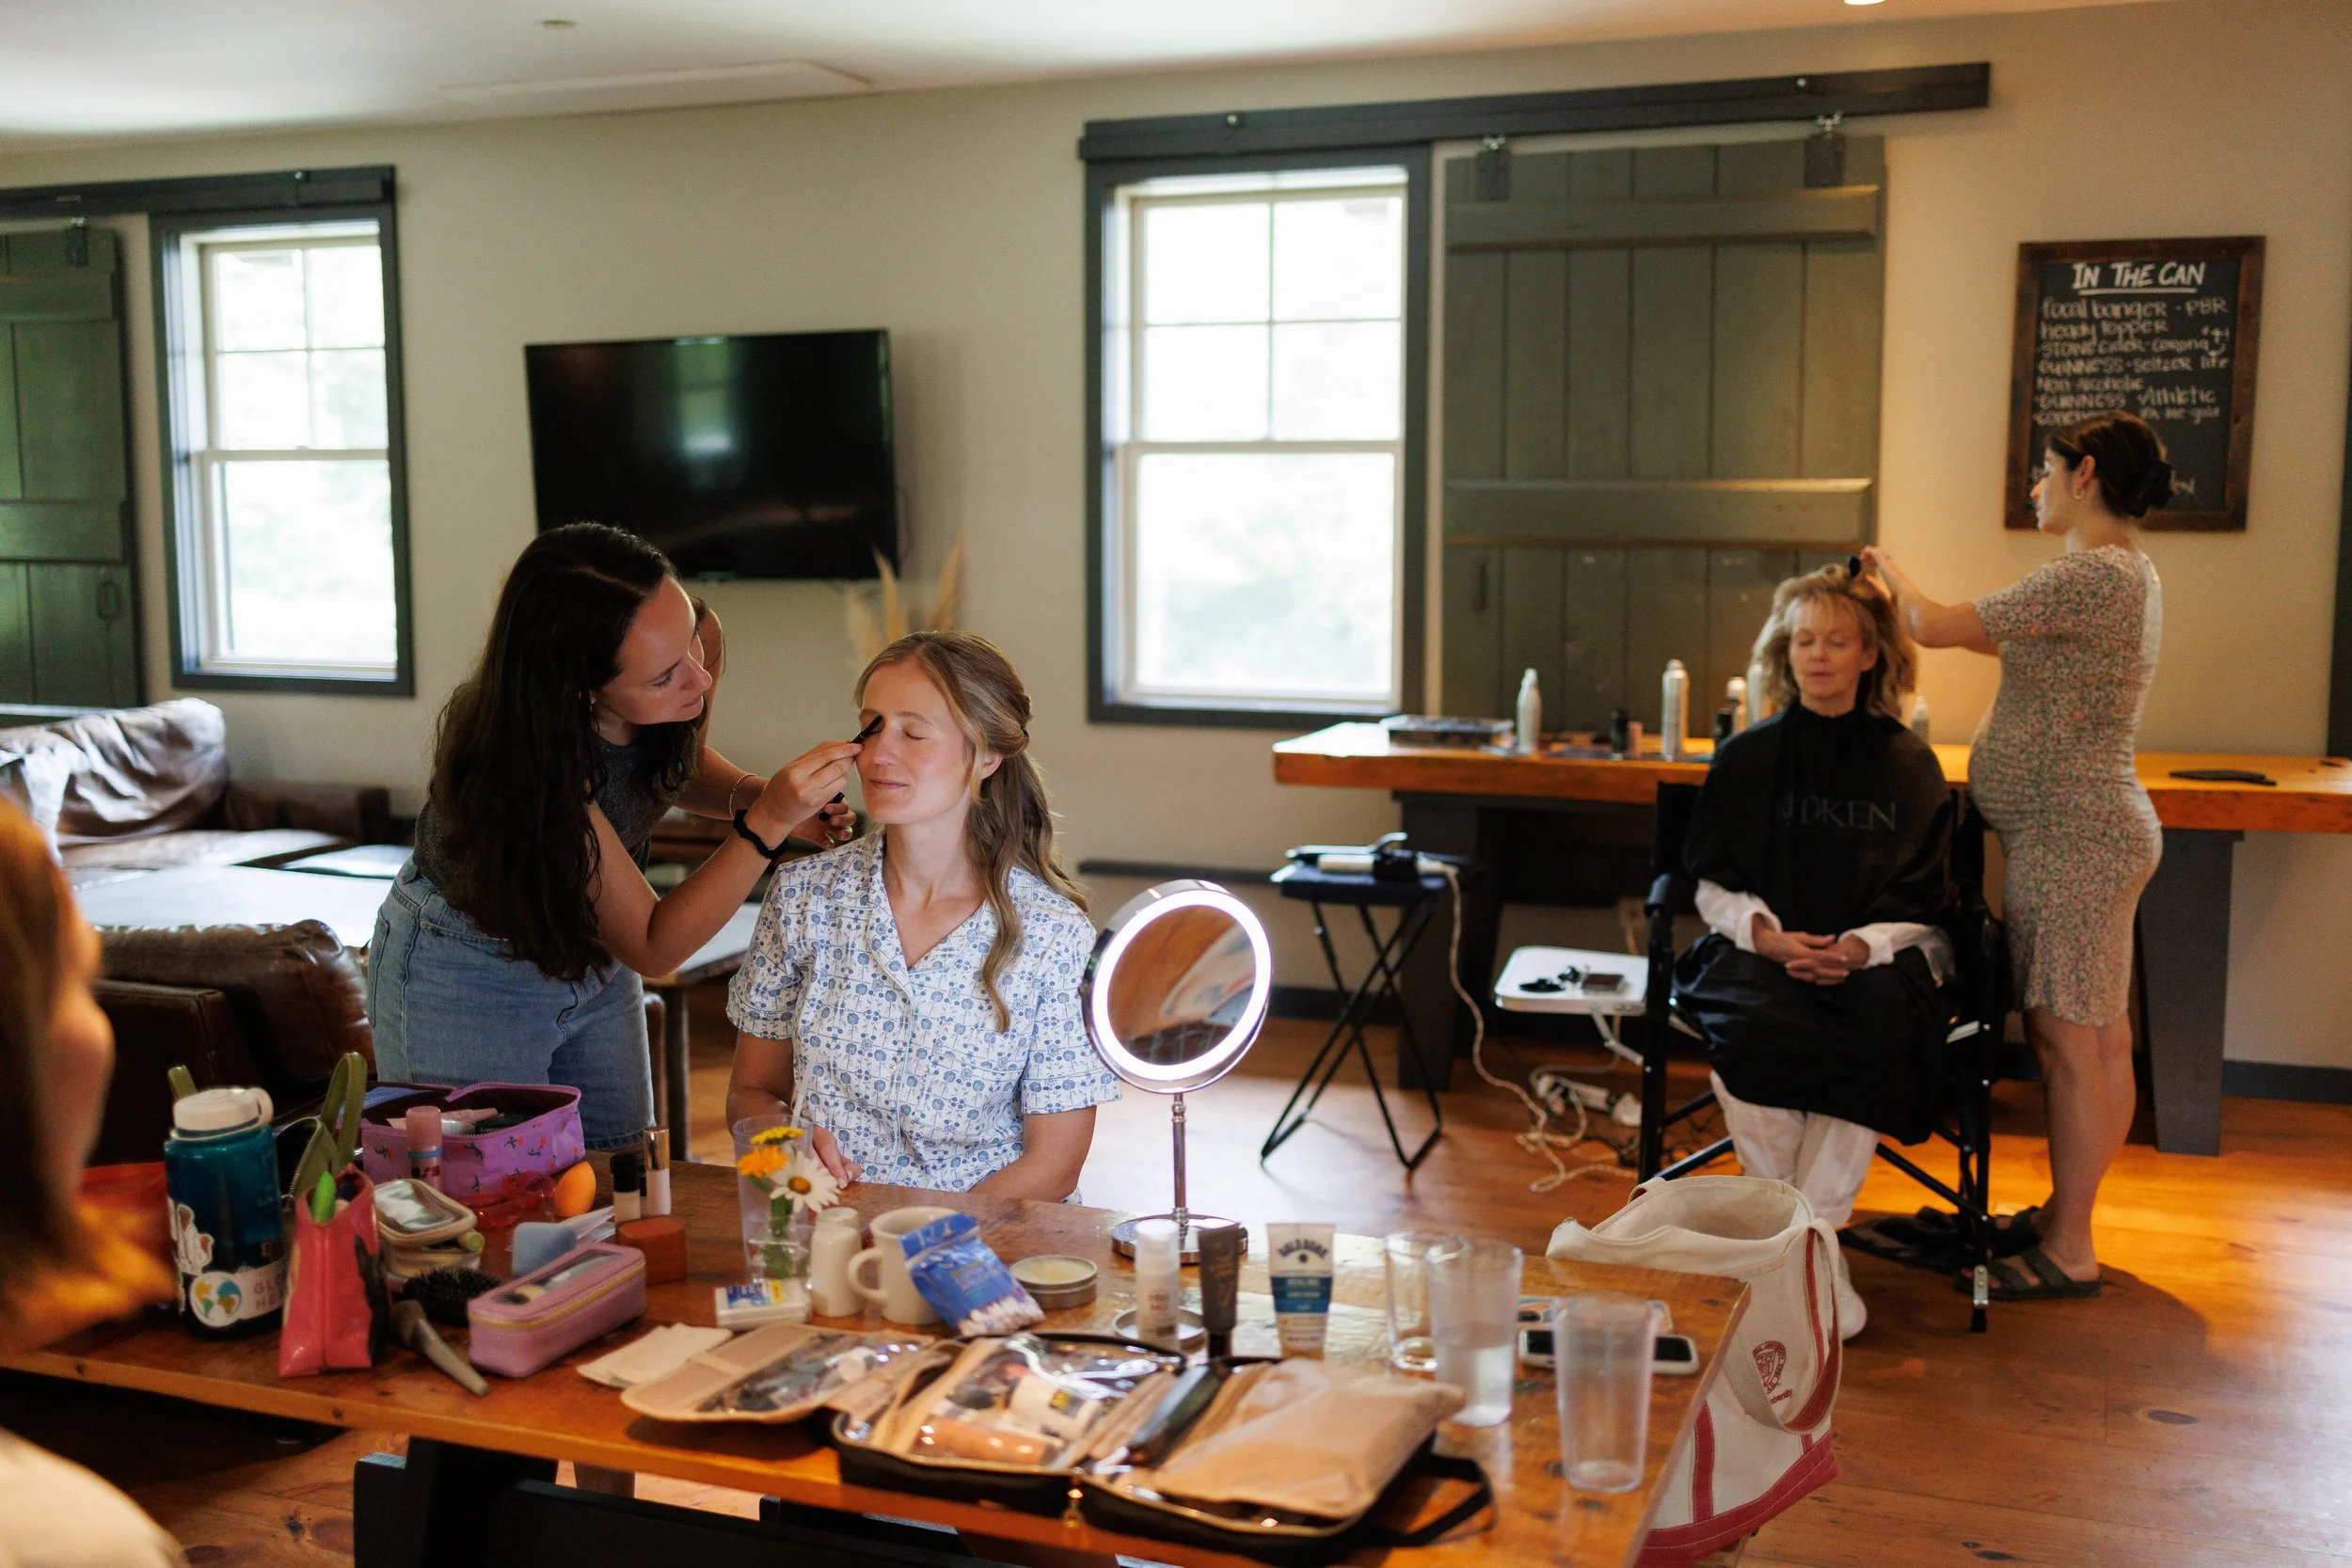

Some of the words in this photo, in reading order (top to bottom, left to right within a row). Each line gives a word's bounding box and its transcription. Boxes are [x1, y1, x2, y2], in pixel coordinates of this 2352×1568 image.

[2073, 262, 2100, 289] IN
[2111, 261, 2155, 288] THE
[2158, 261, 2205, 286] CAN
